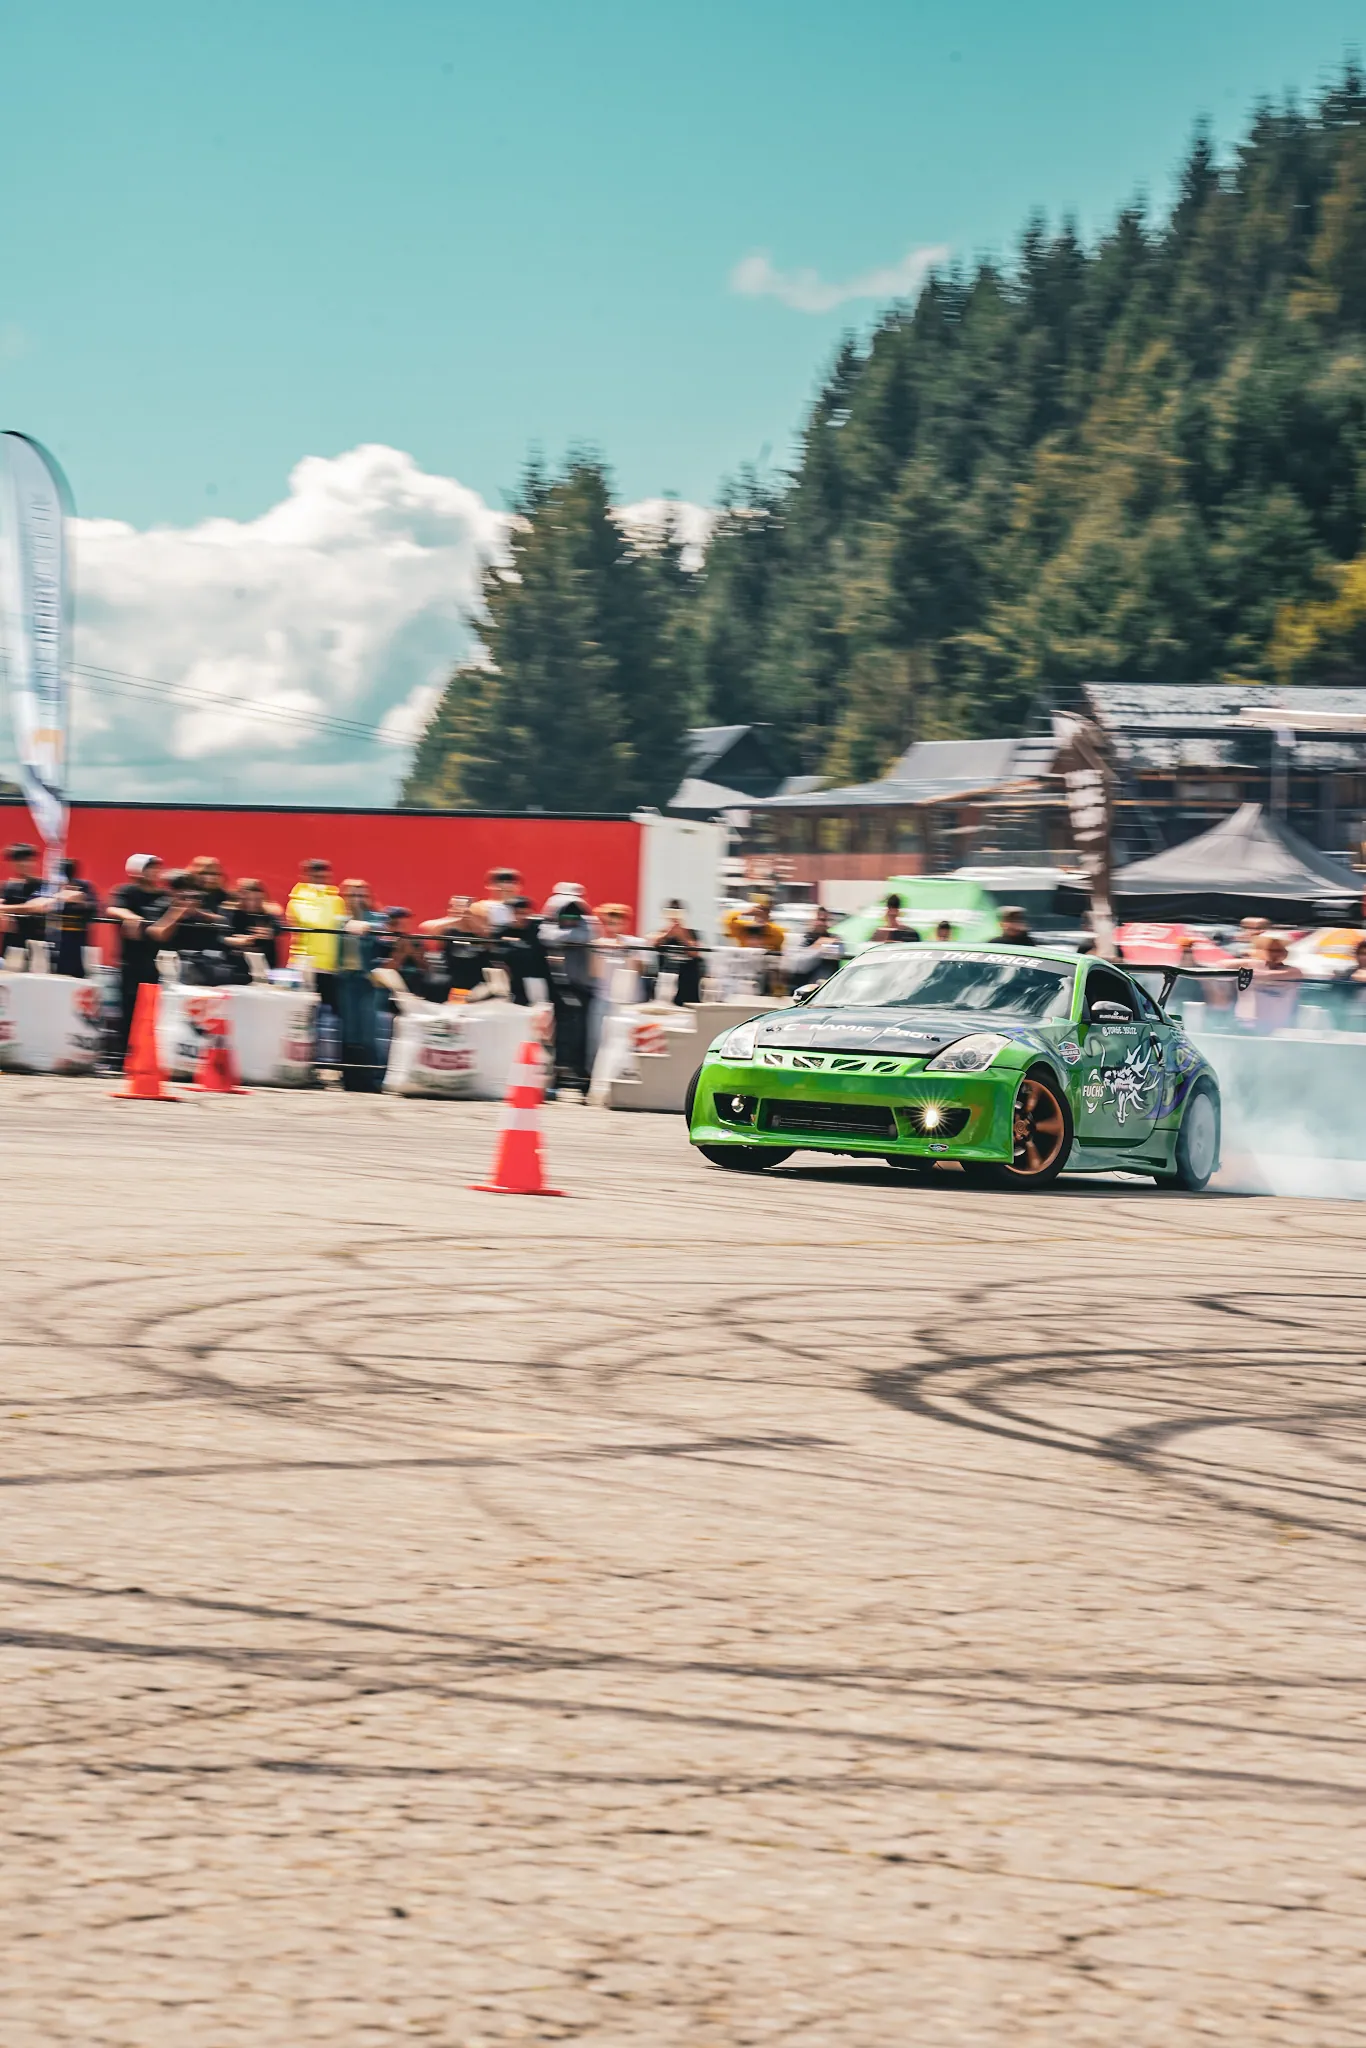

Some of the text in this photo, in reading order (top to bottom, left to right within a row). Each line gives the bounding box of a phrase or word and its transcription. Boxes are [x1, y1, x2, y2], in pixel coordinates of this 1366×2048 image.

[887, 951, 1043, 968] FEEL THE RACE
[1082, 1085, 1104, 1098] FUCHS
